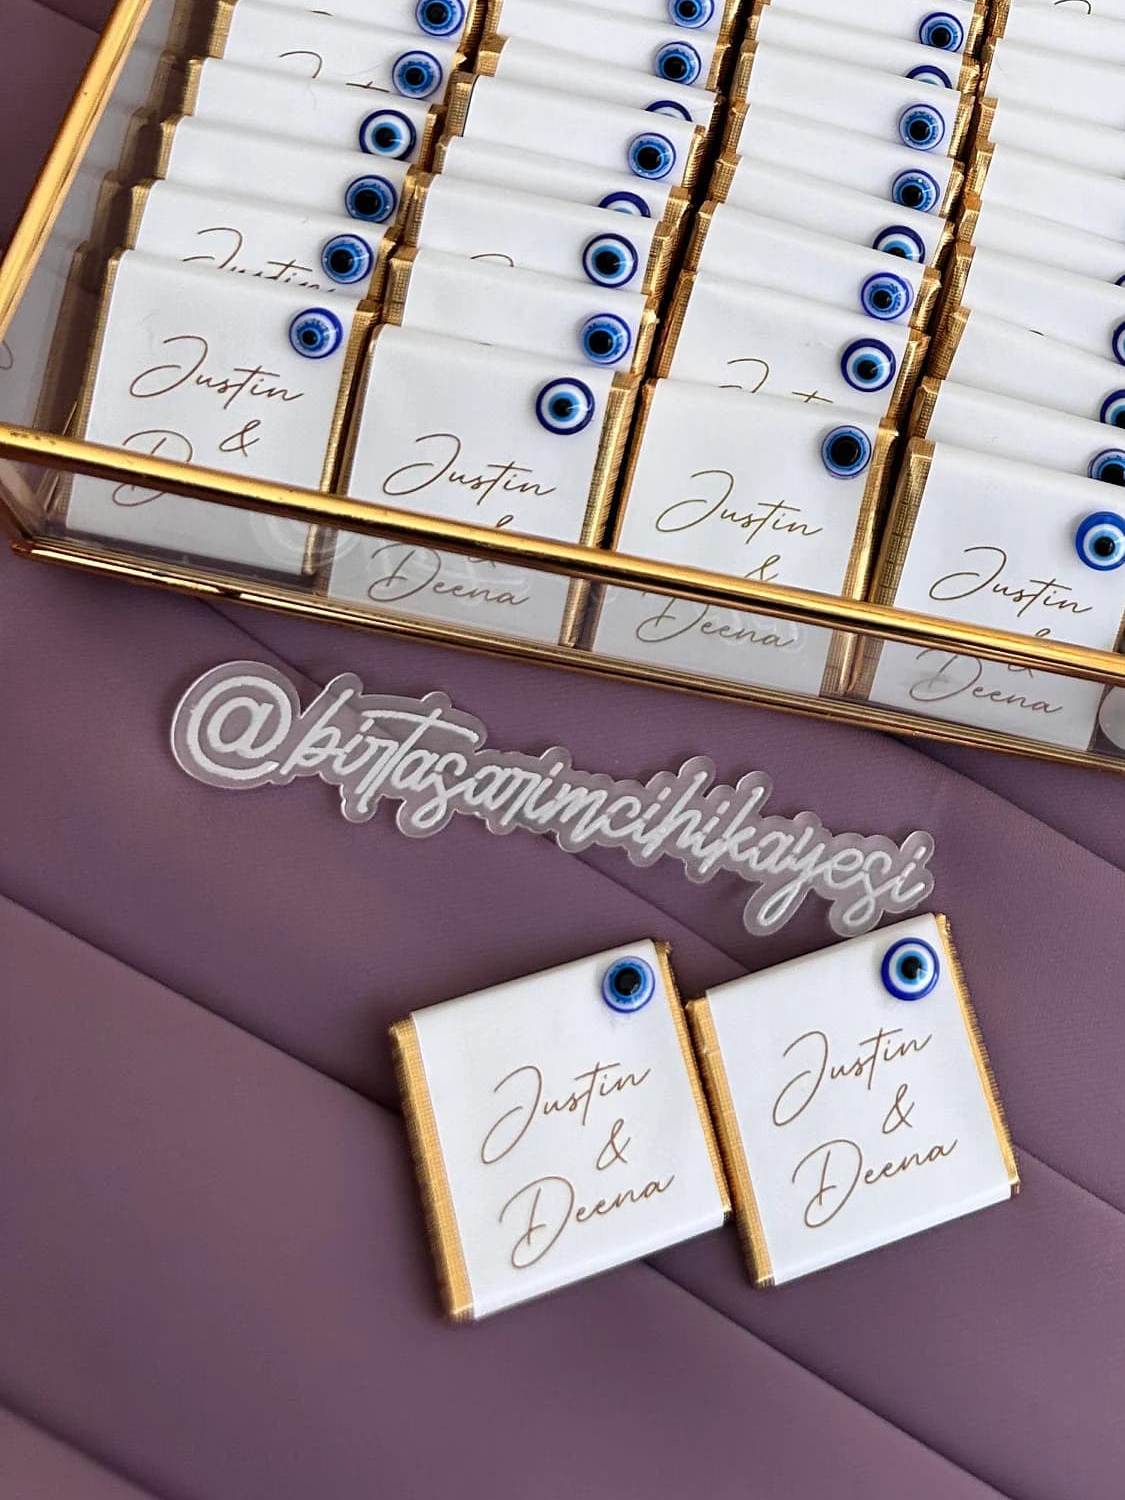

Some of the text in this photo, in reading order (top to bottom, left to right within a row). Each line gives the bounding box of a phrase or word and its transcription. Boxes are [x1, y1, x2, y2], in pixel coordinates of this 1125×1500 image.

[129, 335, 305, 411] Justin
[218, 419, 261, 457] &
[382, 433, 557, 506] Justin
[655, 469, 824, 544] Justin
[367, 543, 530, 606] Deena
[928, 546, 1093, 618] Justin
[908, 648, 1063, 714] Deena
[186, 675, 926, 927] @birtasarimcihikayesi
[480, 1061, 652, 1166] Justin
[773, 1027, 933, 1127] Justin
[881, 1083, 916, 1136] &
[595, 1118, 632, 1171] &
[791, 1138, 959, 1229] Deena
[498, 1175, 676, 1270] Deena
